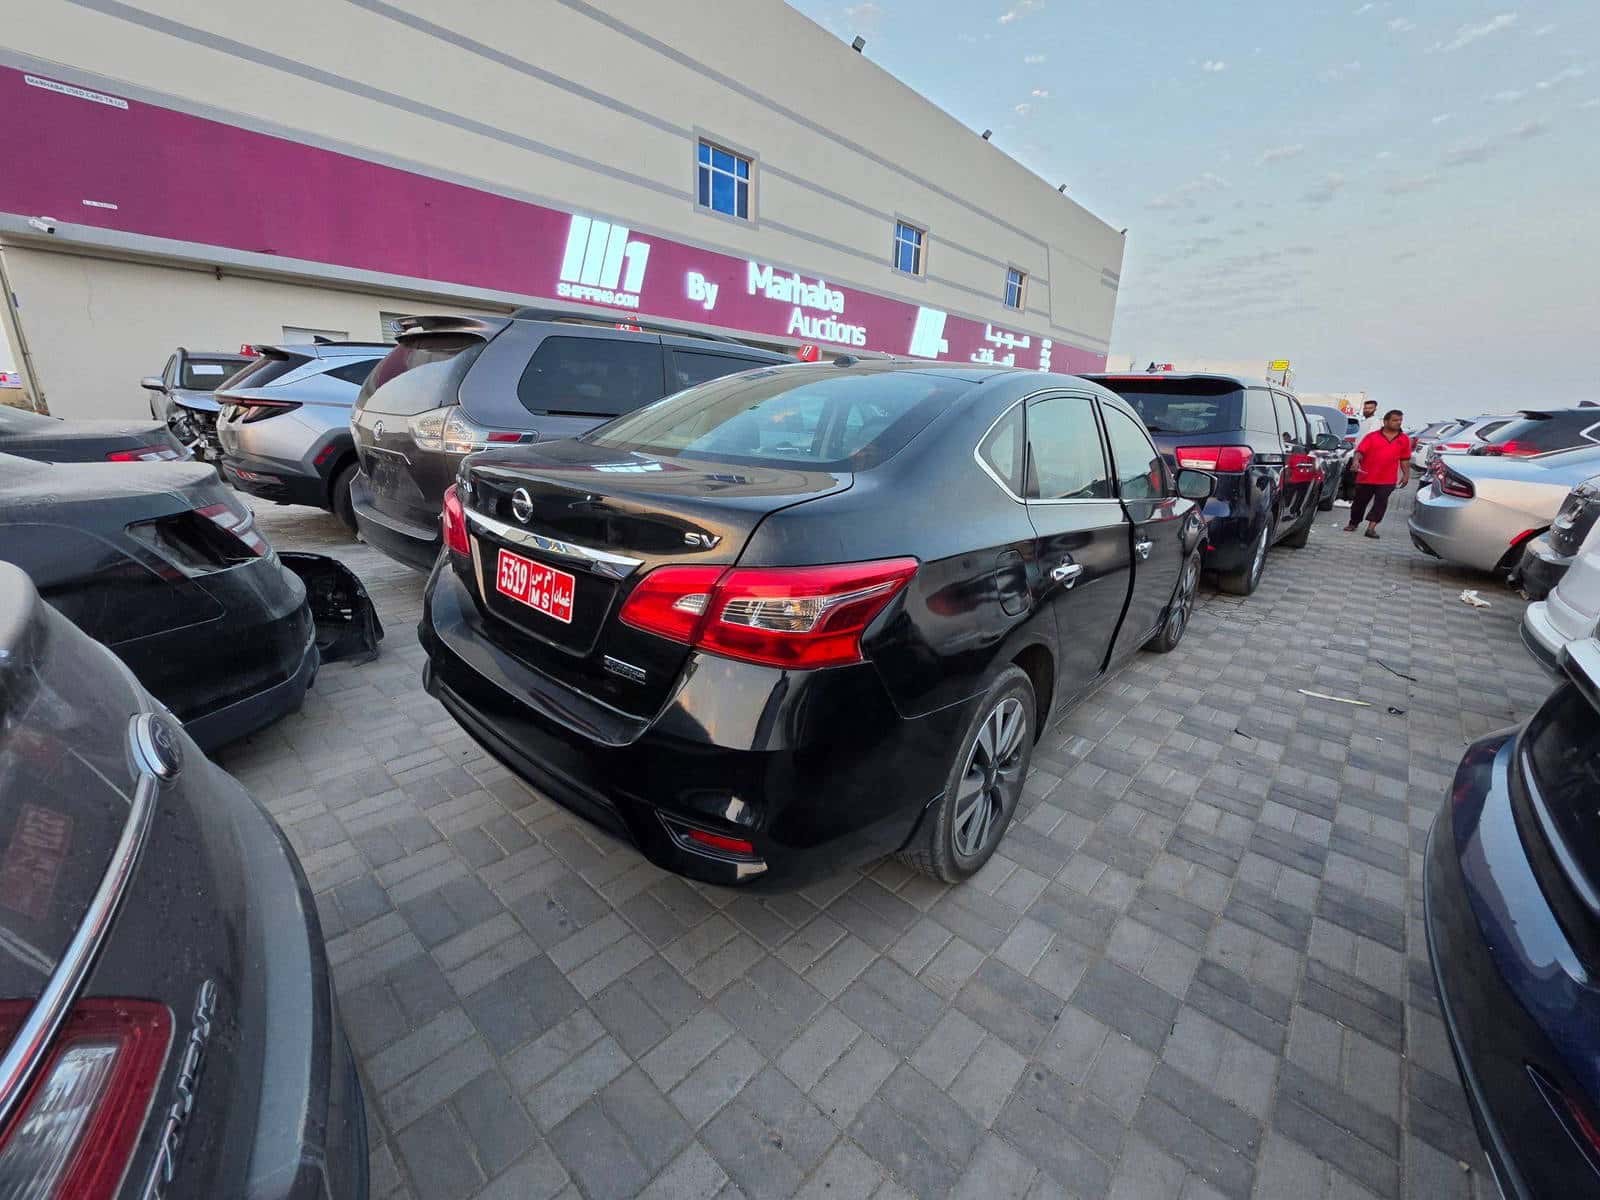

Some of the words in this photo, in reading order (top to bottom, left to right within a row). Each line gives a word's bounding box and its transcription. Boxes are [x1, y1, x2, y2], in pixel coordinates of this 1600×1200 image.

[688, 272, 719, 310] By
[747, 260, 844, 313] Marhaba
[787, 306, 866, 346] Auctions
[684, 531, 722, 549] SV
[502, 557, 527, 596] 5319
[531, 587, 540, 605] M
[542, 592, 550, 609] S
